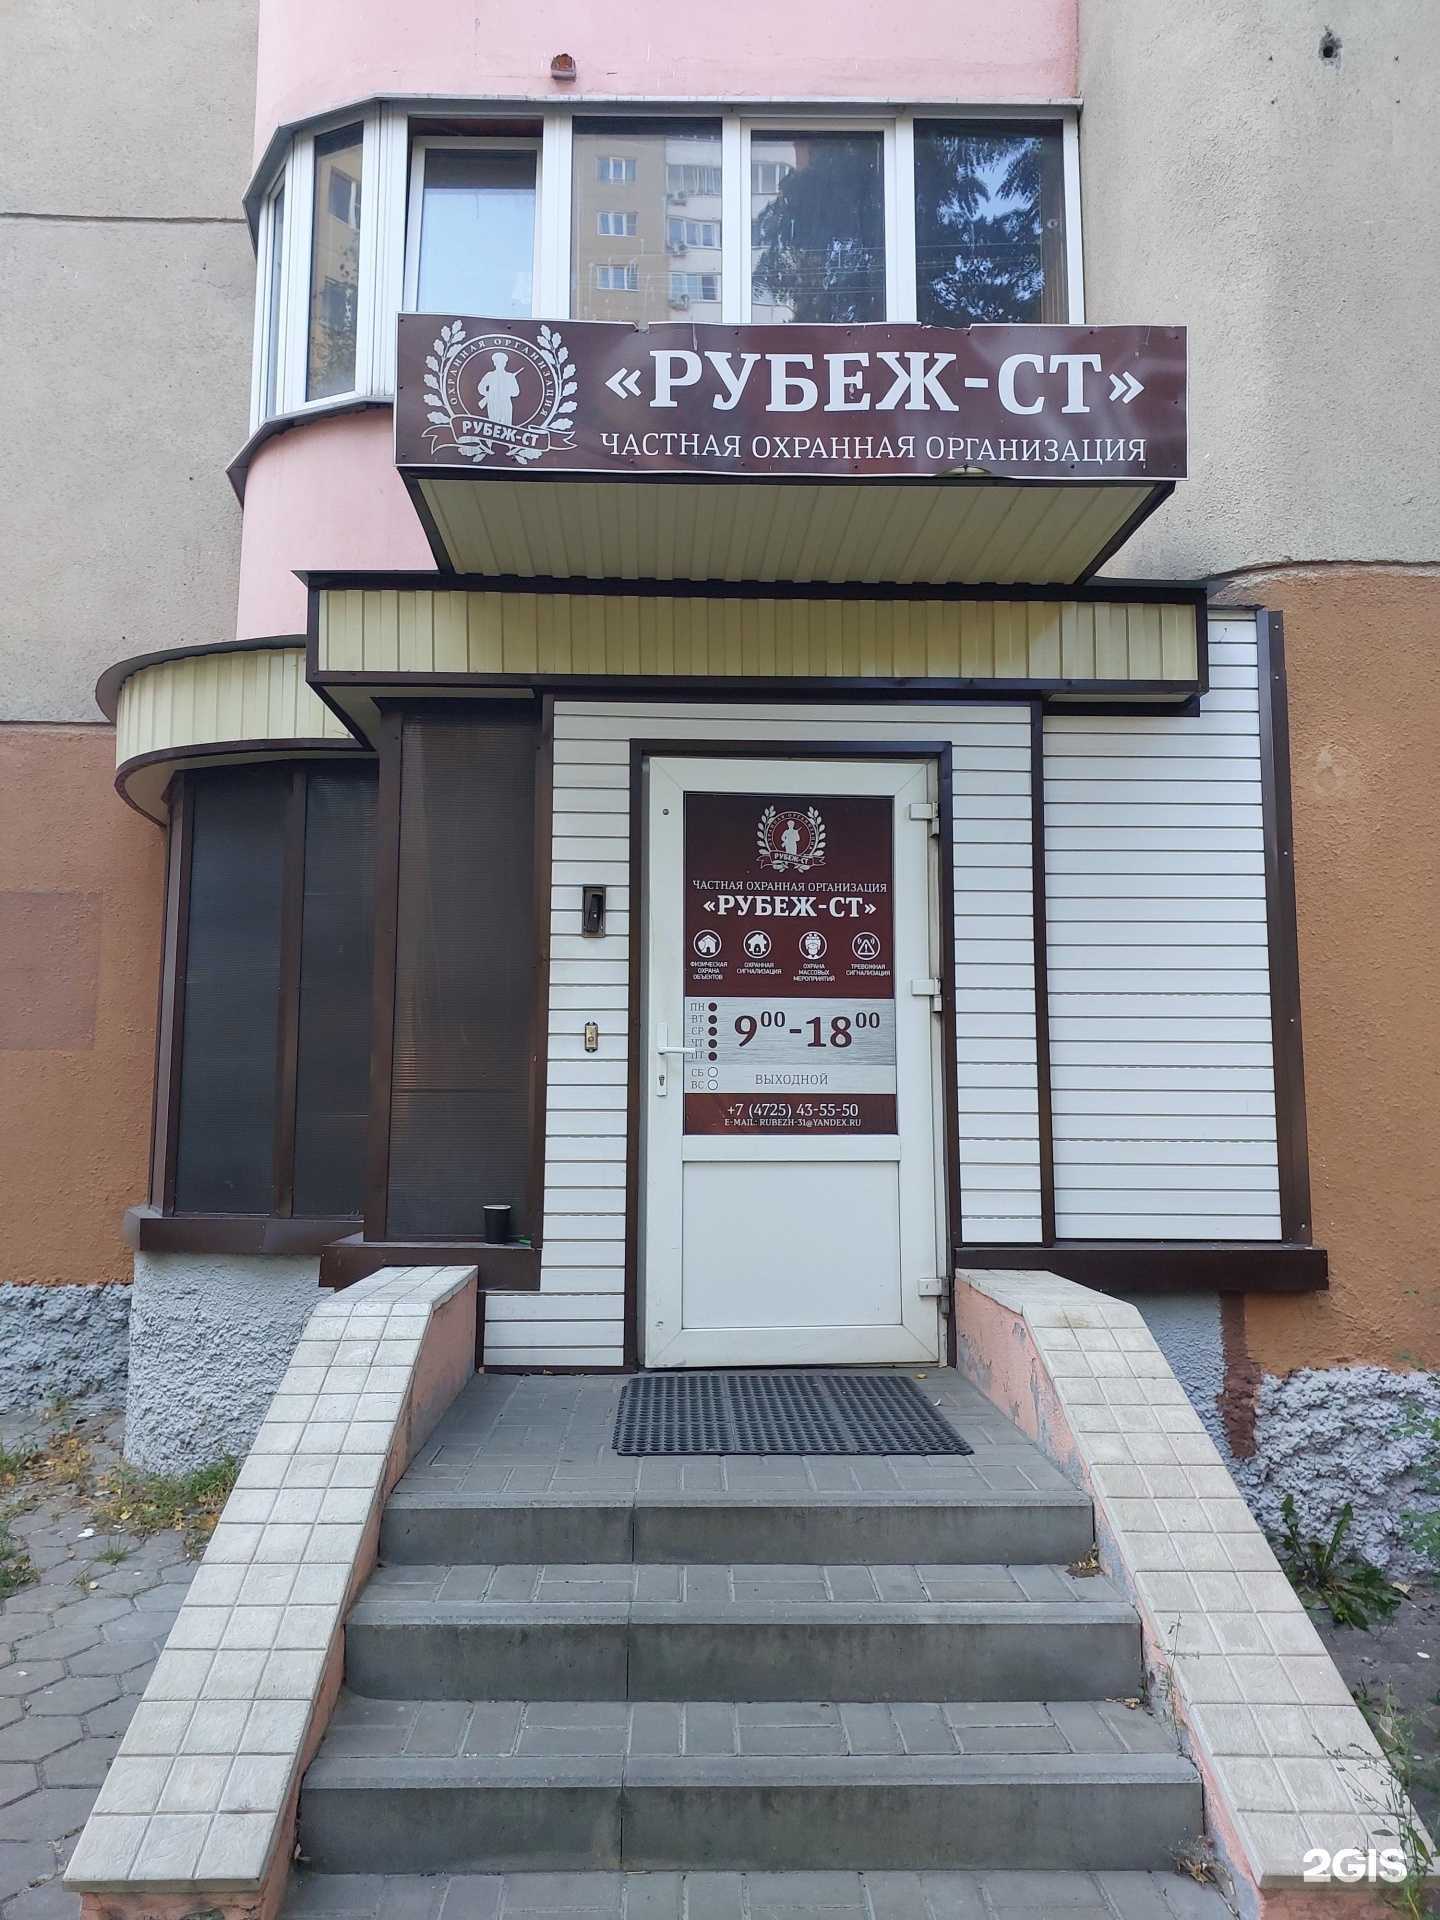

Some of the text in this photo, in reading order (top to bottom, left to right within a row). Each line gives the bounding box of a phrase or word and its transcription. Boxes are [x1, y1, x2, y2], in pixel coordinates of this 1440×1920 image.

[448, 339, 554, 417] ОХРАННАЯ ОРГАНИЗАЦИЯ
[604, 349, 1145, 415] «РУБЕЖ-СТ»
[462, 420, 539, 446] РУБЕЖ-СТ
[601, 432, 1147, 466] ЧАСТНАЯ ОХРАННАЯ ОРГАНИЗАЦИЯ
[774, 852, 809, 865] РУБЕЖ-СТ
[693, 880, 887, 893] ЧАСТНАЯ ОХРАННАЯ ОРГАНИЗАЦИЯ
[703, 894, 877, 918] «РУБЕЖ-СТ»
[690, 1002, 705, 1012] ПН
[691, 1014, 705, 1024] ВТ
[691, 1026, 705, 1036] СР
[691, 1038, 705, 1048] ЧТ
[691, 1068, 705, 1077] СБ
[755, 1072, 829, 1085] ВЫХОДНОЙ
[691, 1080, 705, 1090] ВС
[727, 1103, 859, 1118] +7 (4725) 43-55-50
[760, 1118, 861, 1128] RUBEZH-31@YANDEX.RU
